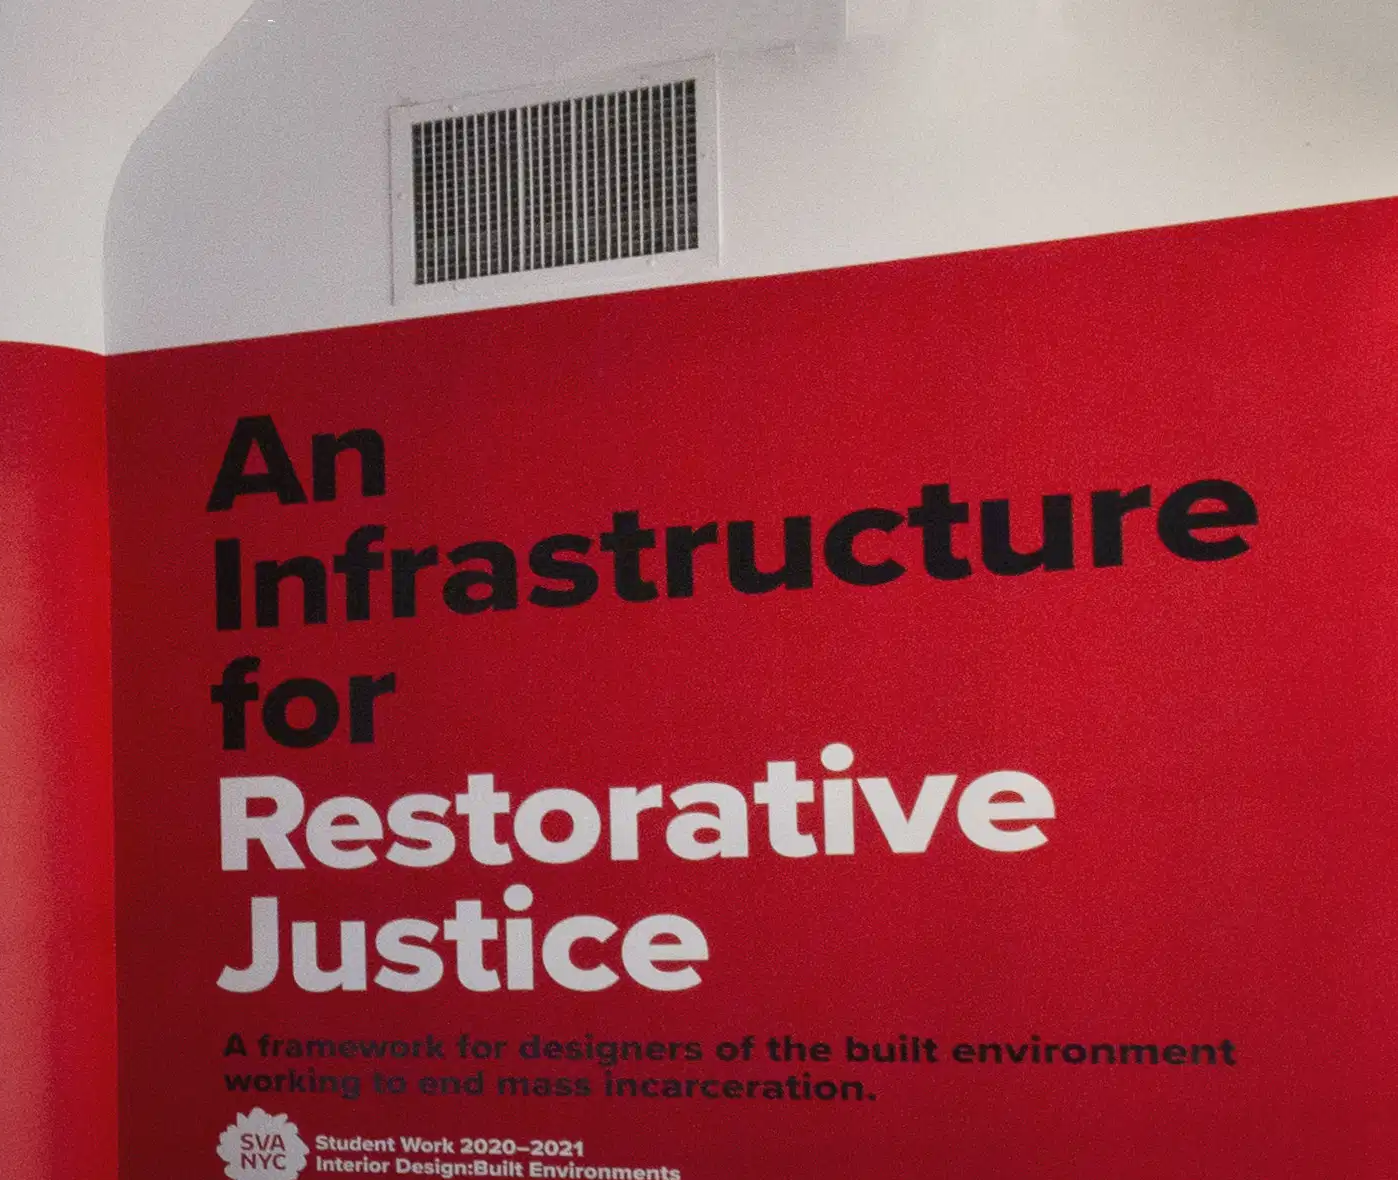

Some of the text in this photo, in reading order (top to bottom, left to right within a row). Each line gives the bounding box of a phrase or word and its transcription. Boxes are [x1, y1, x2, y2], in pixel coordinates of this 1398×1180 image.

[207, 415, 385, 512] An
[215, 478, 1257, 631] Infrastructure
[211, 656, 395, 750] for
[220, 743, 1055, 870] Restorative
[217, 884, 709, 992] Justice
[224, 1033, 1238, 1067] A framework for designers of the built environment
[224, 1070, 876, 1102] working to end mass incarceration.
[239, 1133, 285, 1151] SVA
[315, 1135, 395, 1153] Student
[400, 1136, 455, 1154] Work
[240, 1152, 287, 1171] NYC
[316, 1156, 390, 1173] Interior
[395, 1157, 524, 1179] Design:Built
